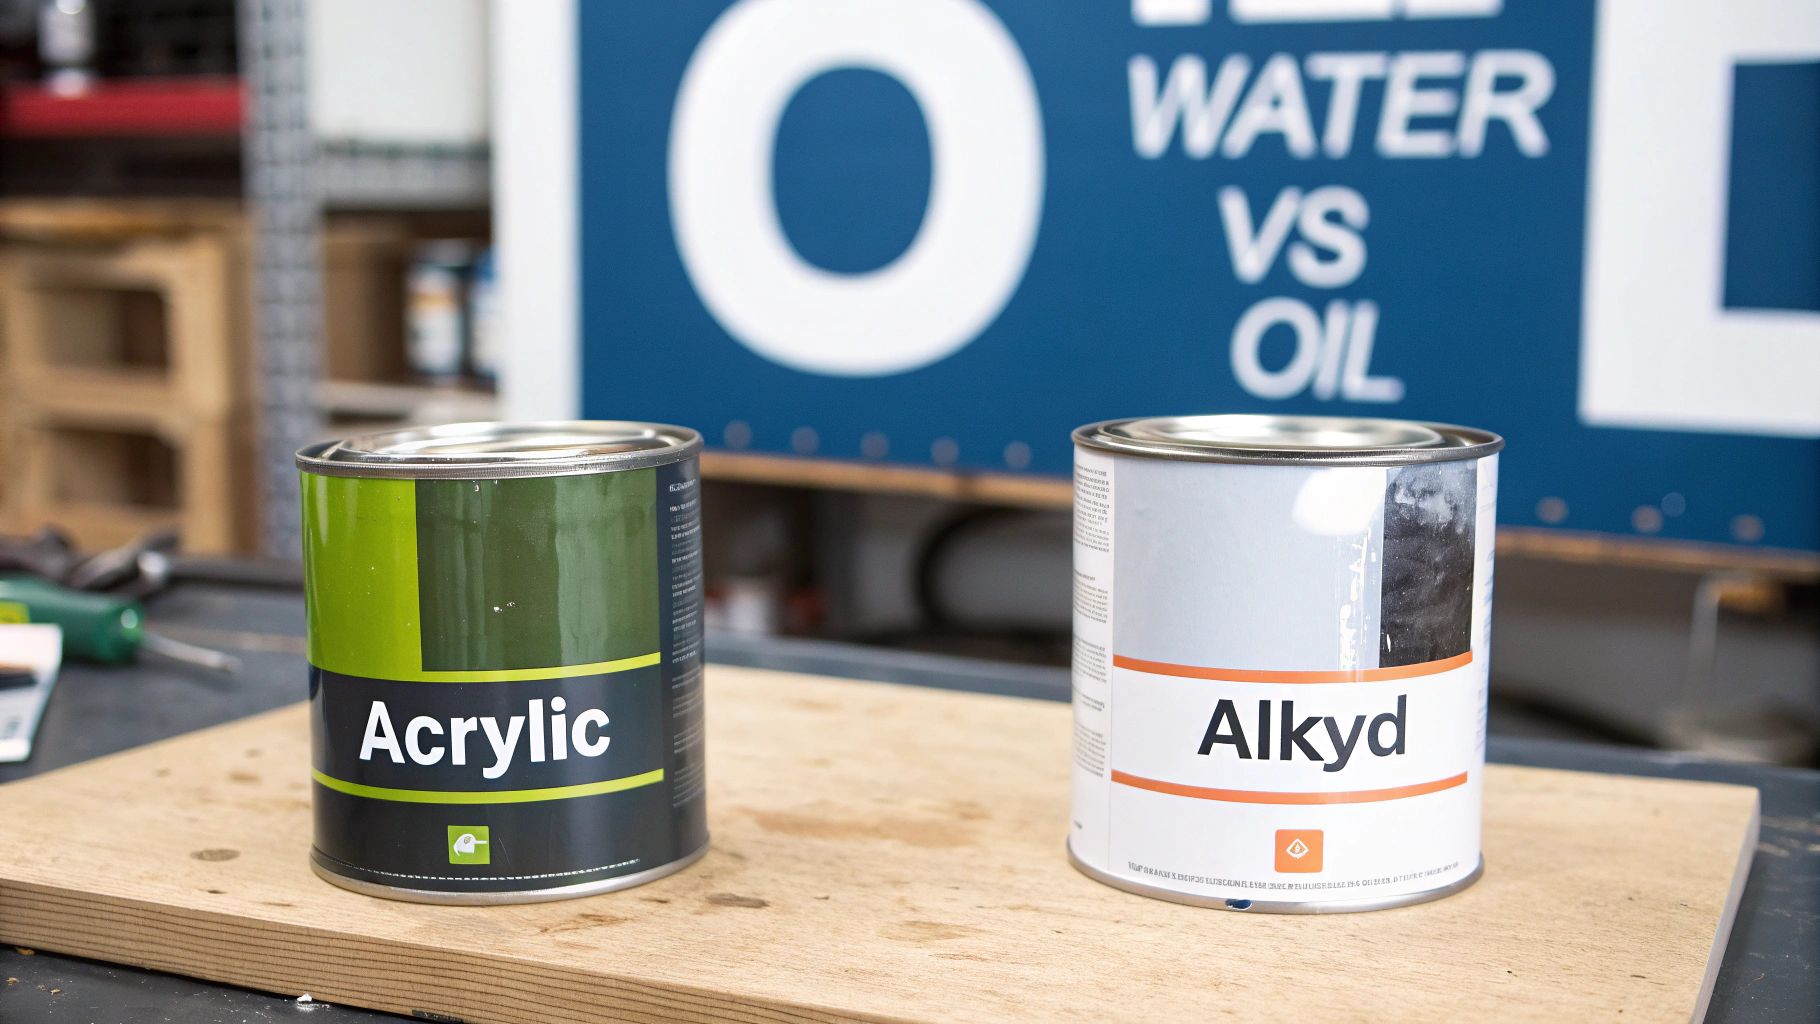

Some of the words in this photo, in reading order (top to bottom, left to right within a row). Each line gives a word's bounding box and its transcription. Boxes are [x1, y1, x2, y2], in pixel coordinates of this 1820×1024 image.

[1129, 50, 1555, 158] WATER
[1219, 186, 1369, 287] VS
[1230, 297, 1404, 402] OIL
[359, 695, 612, 780] Acrylic
[1197, 694, 1408, 774] Alkyd
